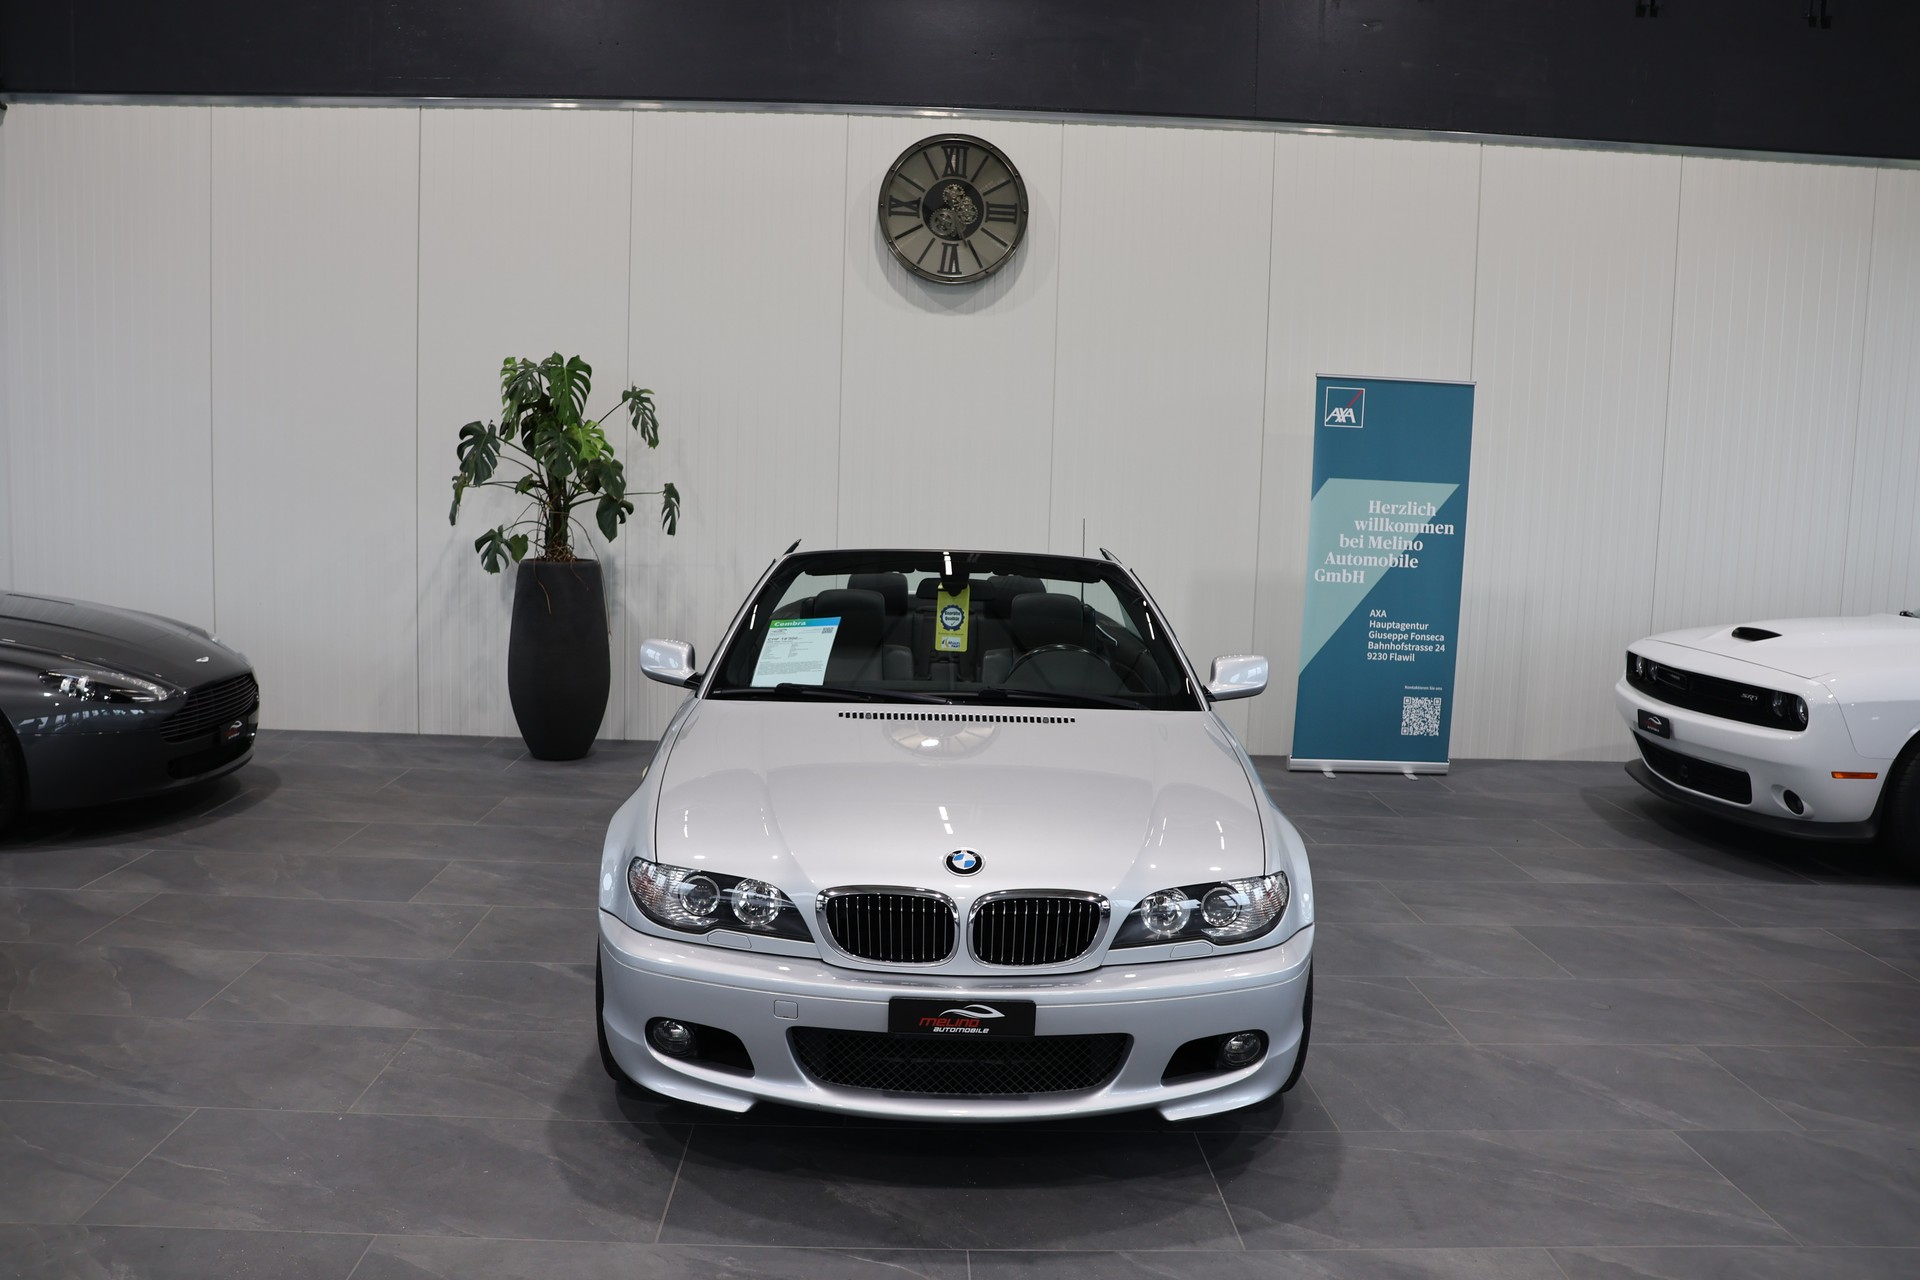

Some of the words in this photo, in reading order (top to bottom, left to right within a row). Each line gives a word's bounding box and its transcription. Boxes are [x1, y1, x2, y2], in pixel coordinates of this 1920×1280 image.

[941, 144, 970, 179] XII
[1325, 407, 1356, 424] AXA
[1368, 500, 1436, 516] Herzlich
[1354, 517, 1455, 535] willkommen
[1340, 533, 1364, 549] bei
[1368, 535, 1424, 551] Melino
[1324, 551, 1419, 568] Automobile
[1314, 568, 1365, 584] GmbH
[1369, 609, 1387, 618] AXA
[1369, 620, 1429, 631] Hauptagentur
[1368, 631, 1409, 641] Giuseppe
[1410, 633, 1445, 642] Fonseca
[1368, 641, 1434, 652] Bahnhofstrasse
[1434, 644, 1445, 652] 24
[1367, 652, 1388, 661] 9230
[1389, 653, 1415, 662] Flawil
